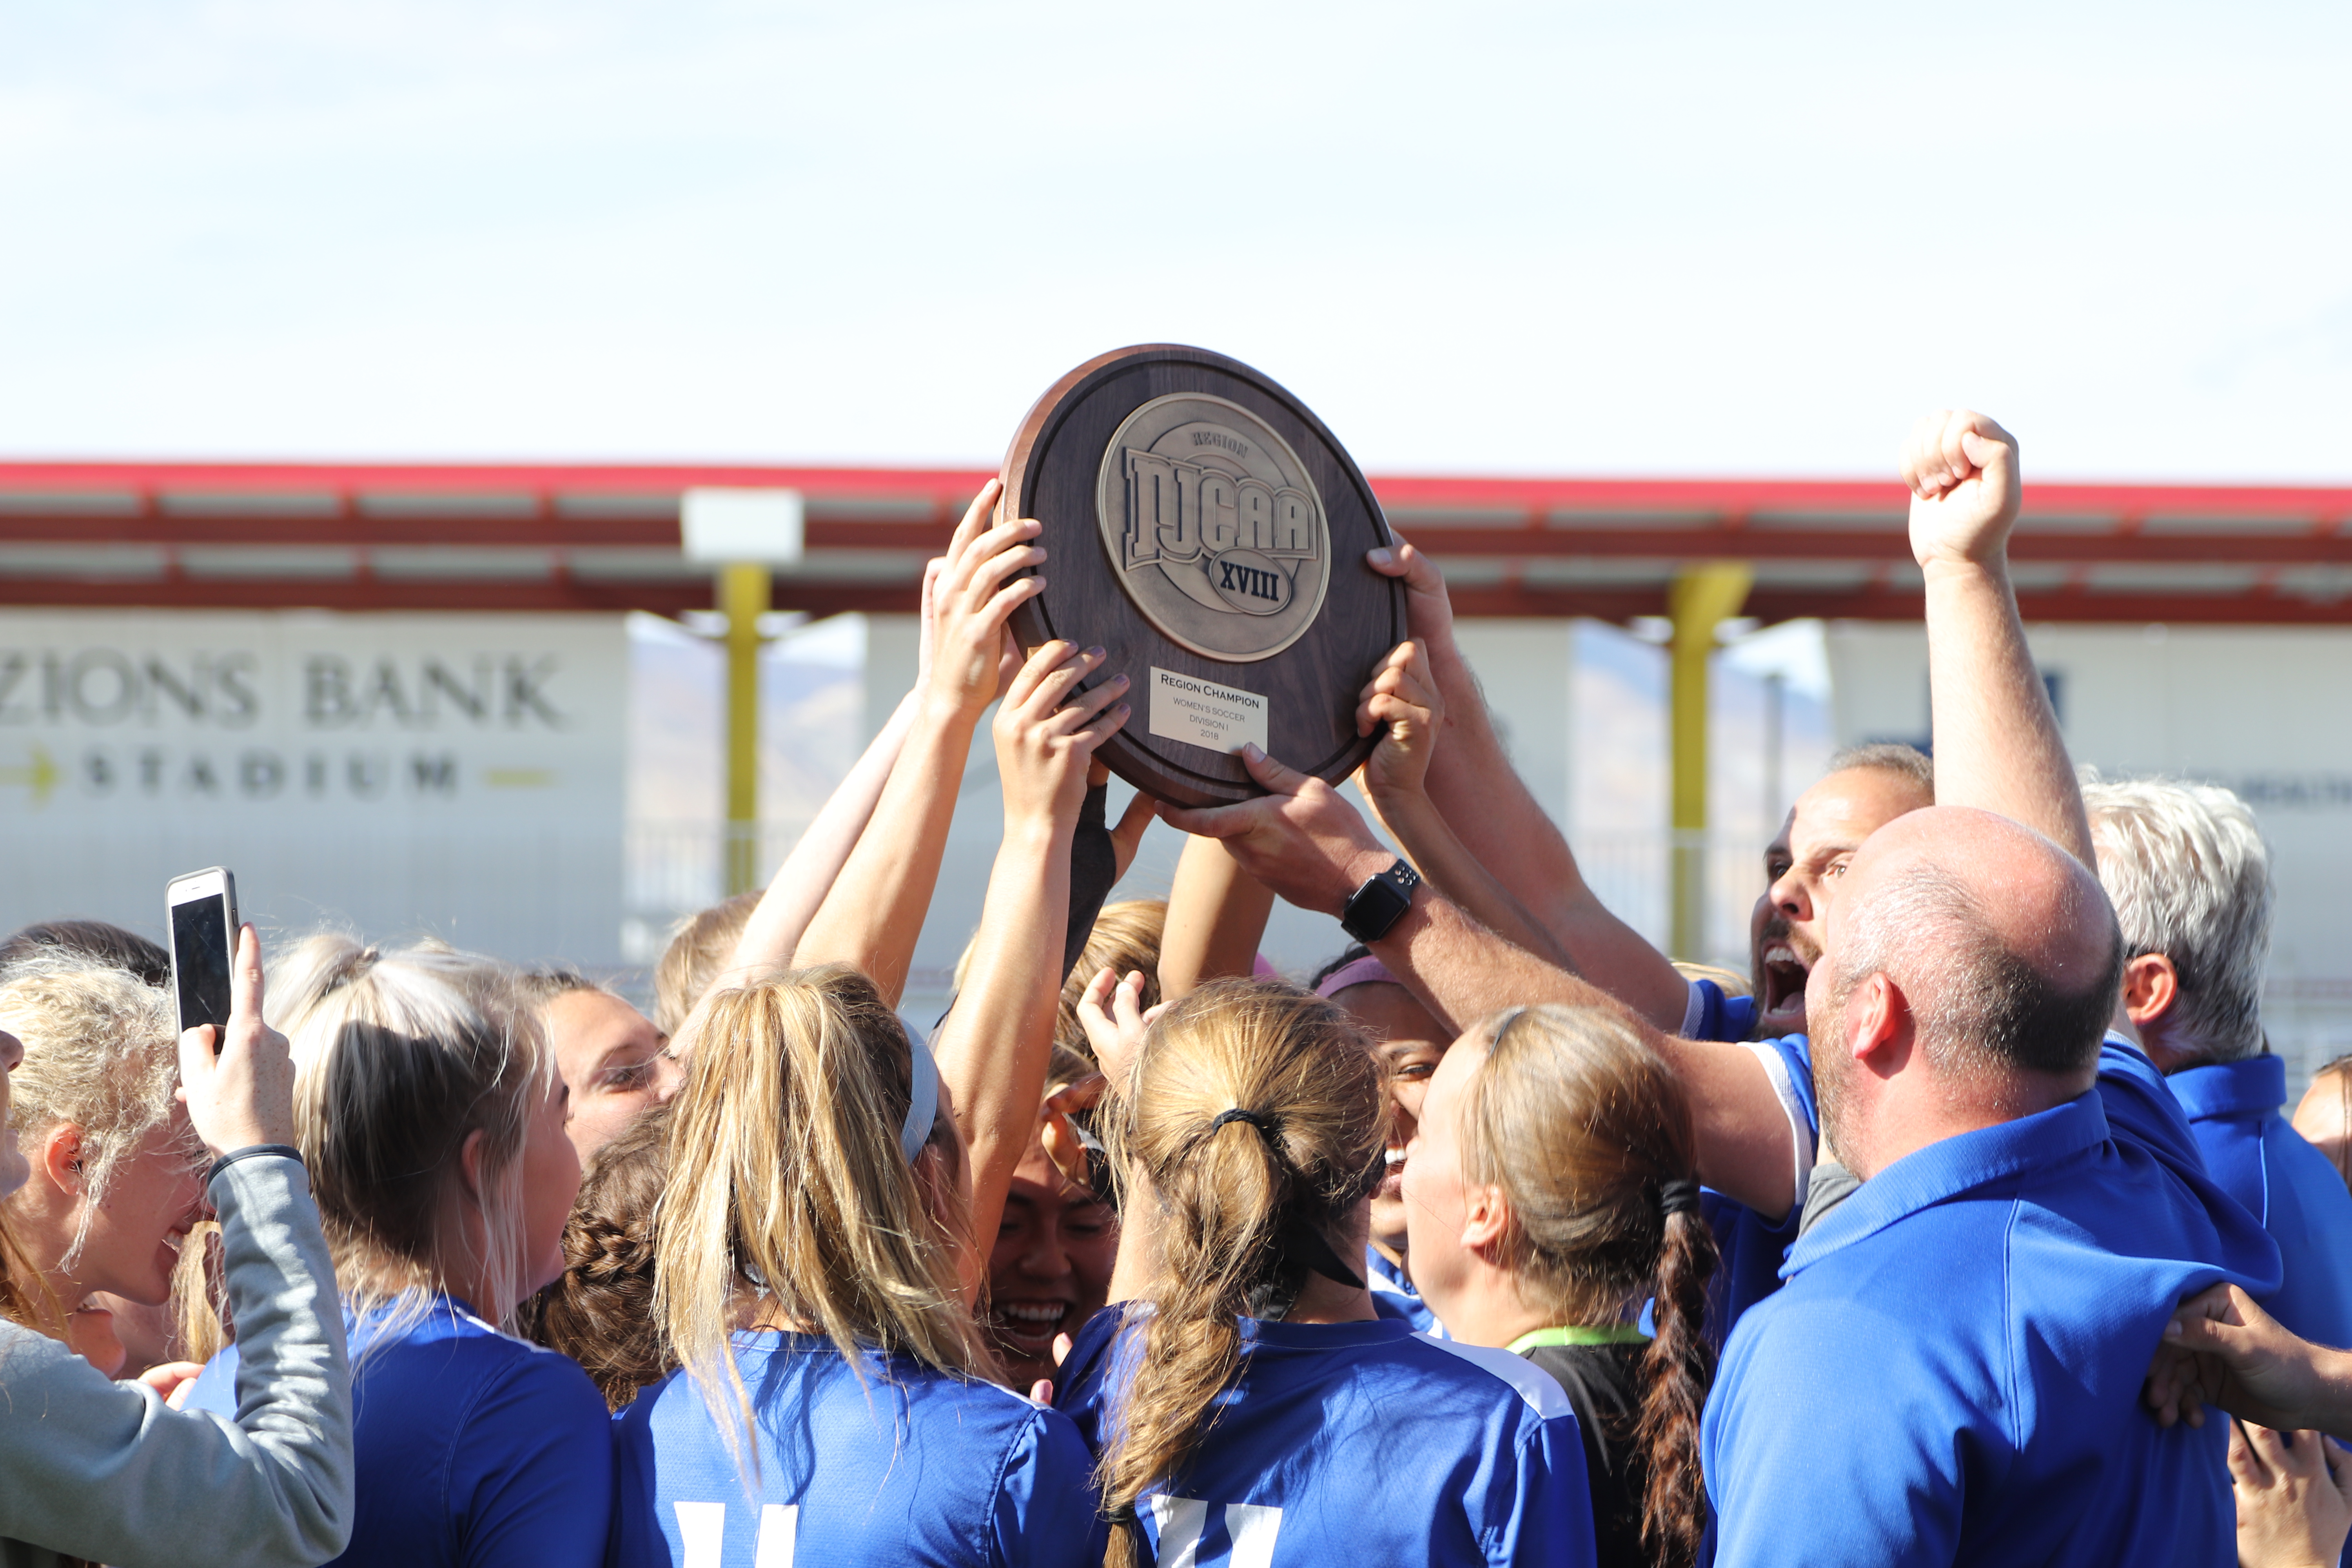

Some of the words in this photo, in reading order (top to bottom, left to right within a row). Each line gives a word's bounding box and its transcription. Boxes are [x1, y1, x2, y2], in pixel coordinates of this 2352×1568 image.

[1193, 432, 1248, 457] REGION
[1131, 456, 1311, 558] NJCAA
[1220, 561, 1279, 601] XVIII
[0, 648, 263, 730] ZIONS
[302, 652, 570, 731] BANK
[1161, 674, 1200, 693] REGION
[1204, 686, 1259, 708] CHAMPION
[1173, 697, 1210, 713] WOMEN'S
[1212, 708, 1245, 722] SOCCER
[1190, 715, 1224, 730] DIVISION
[1201, 730, 1219, 740] 2018
[81, 746, 460, 802] STADIUM
